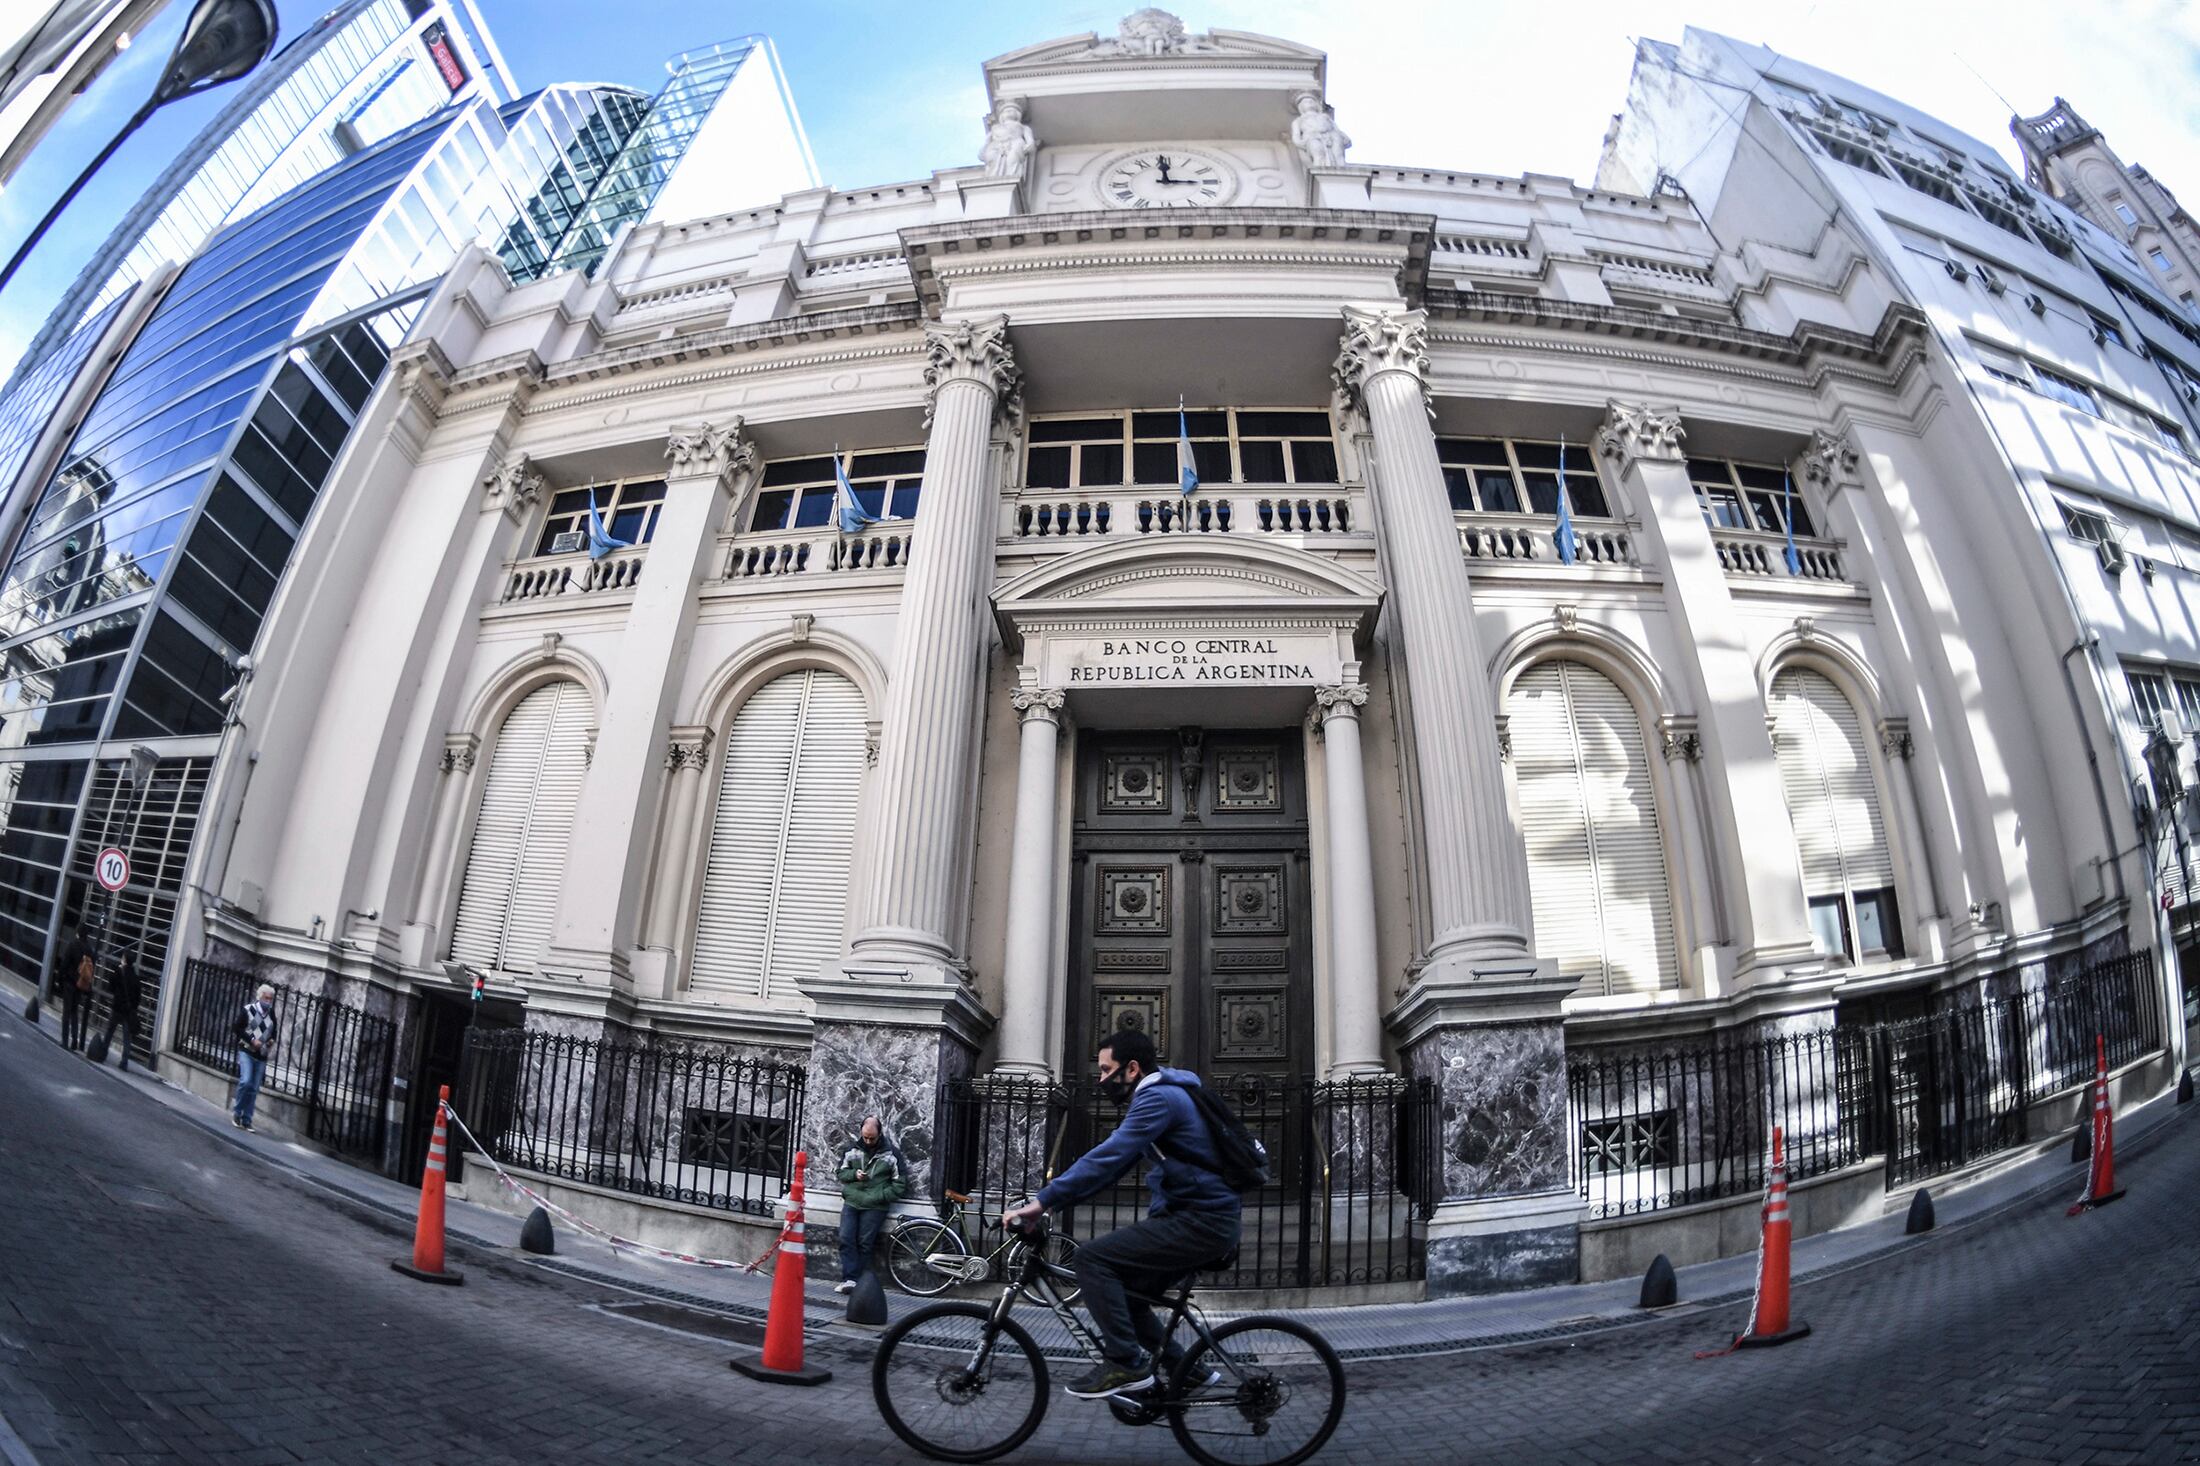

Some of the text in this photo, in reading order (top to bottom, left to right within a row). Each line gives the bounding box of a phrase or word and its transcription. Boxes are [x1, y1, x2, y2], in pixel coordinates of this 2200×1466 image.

[437, 47, 458, 83] Galicia
[1103, 639, 1278, 655] BANCO CENTRAL
[1172, 655, 1208, 664] DE LA
[1070, 664, 1314, 681] REPUBLICA ARGENTINA
[106, 858, 123, 881] 10
